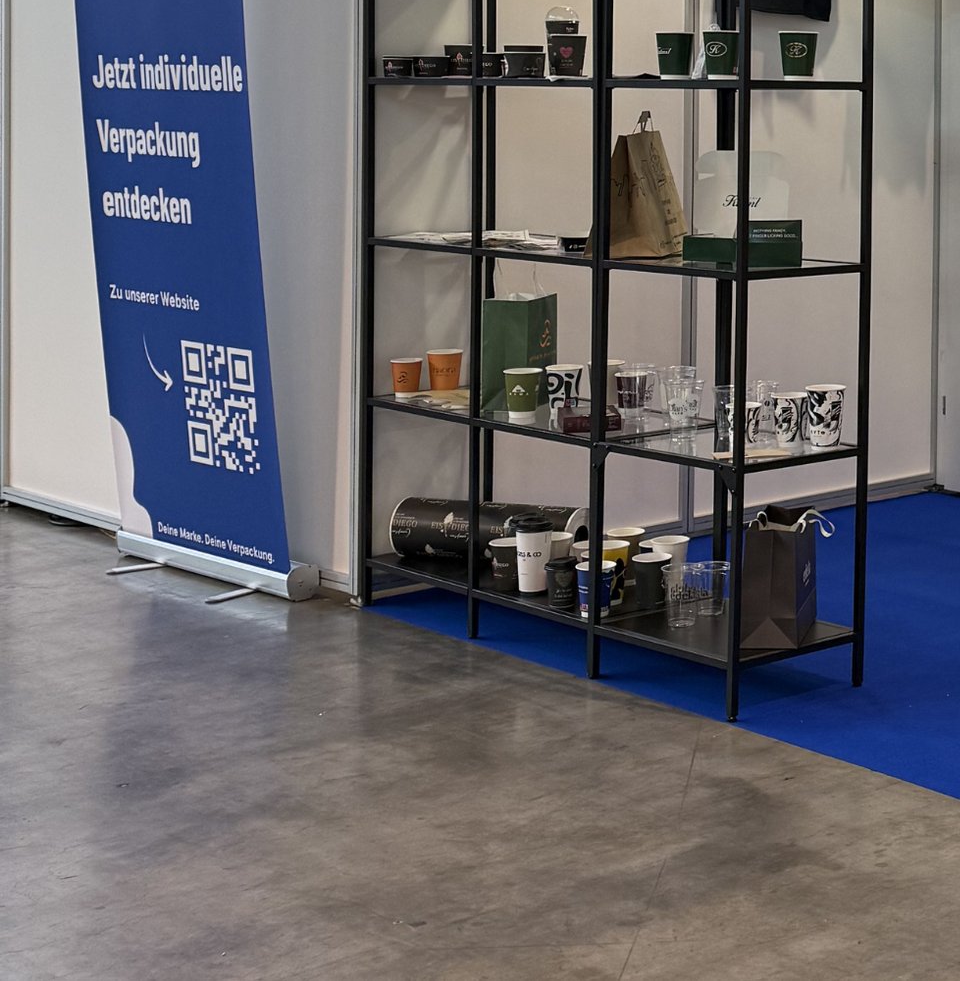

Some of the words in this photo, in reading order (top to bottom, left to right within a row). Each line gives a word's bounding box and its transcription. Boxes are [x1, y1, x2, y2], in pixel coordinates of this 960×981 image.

[92, 54, 137, 89] Jetzt
[139, 53, 243, 92] individuelle
[96, 119, 200, 168] Verpackung
[102, 185, 192, 225] entdecken
[109, 283, 123, 300] Zu
[124, 289, 159, 305] unserer
[160, 291, 200, 311] Website
[157, 521, 178, 537] Deine
[179, 527, 204, 544] Marke.
[204, 534, 227, 550] Deine
[227, 539, 275, 565] Verpackung.
